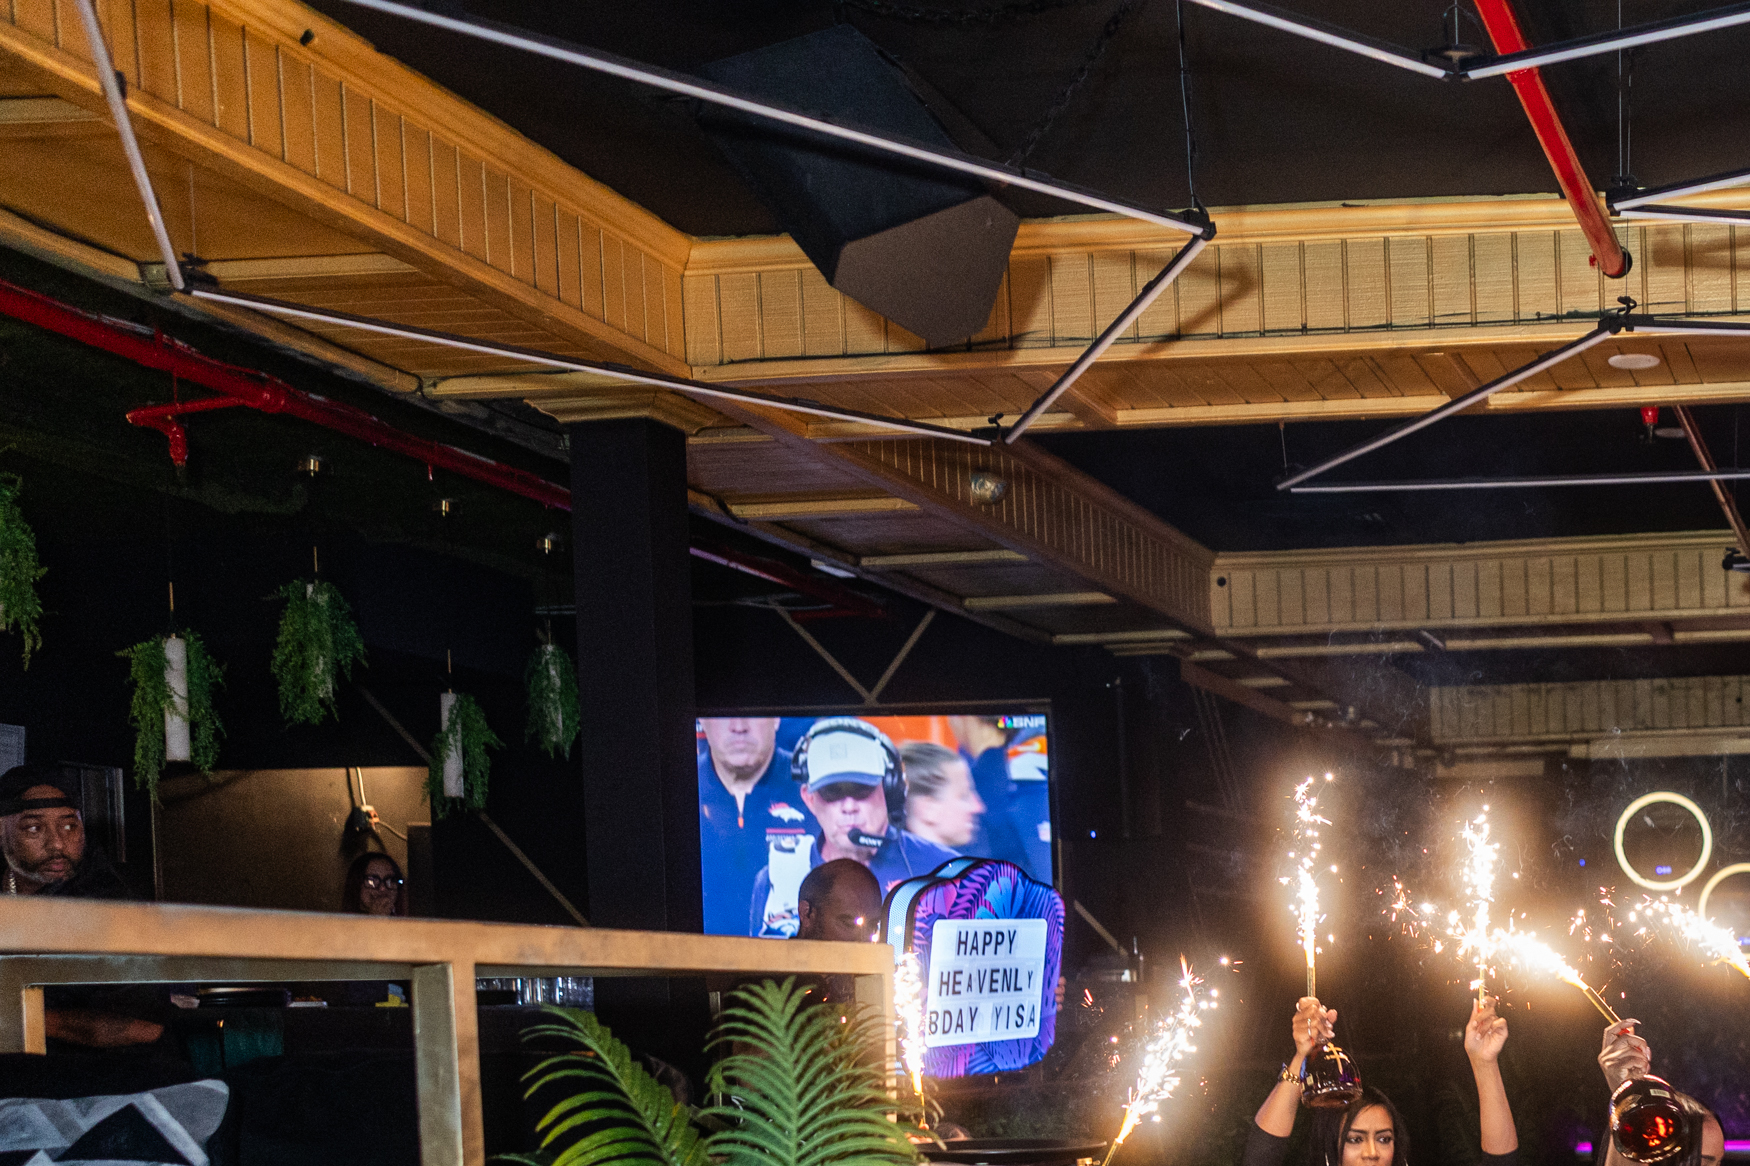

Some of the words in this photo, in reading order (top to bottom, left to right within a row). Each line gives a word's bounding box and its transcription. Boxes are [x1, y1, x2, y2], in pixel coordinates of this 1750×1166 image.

[957, 929, 1017, 956] HAPPY
[939, 967, 1034, 997] HEAVENLY
[928, 1006, 979, 1036] BDAY
[995, 1003, 1036, 1031] YISA
